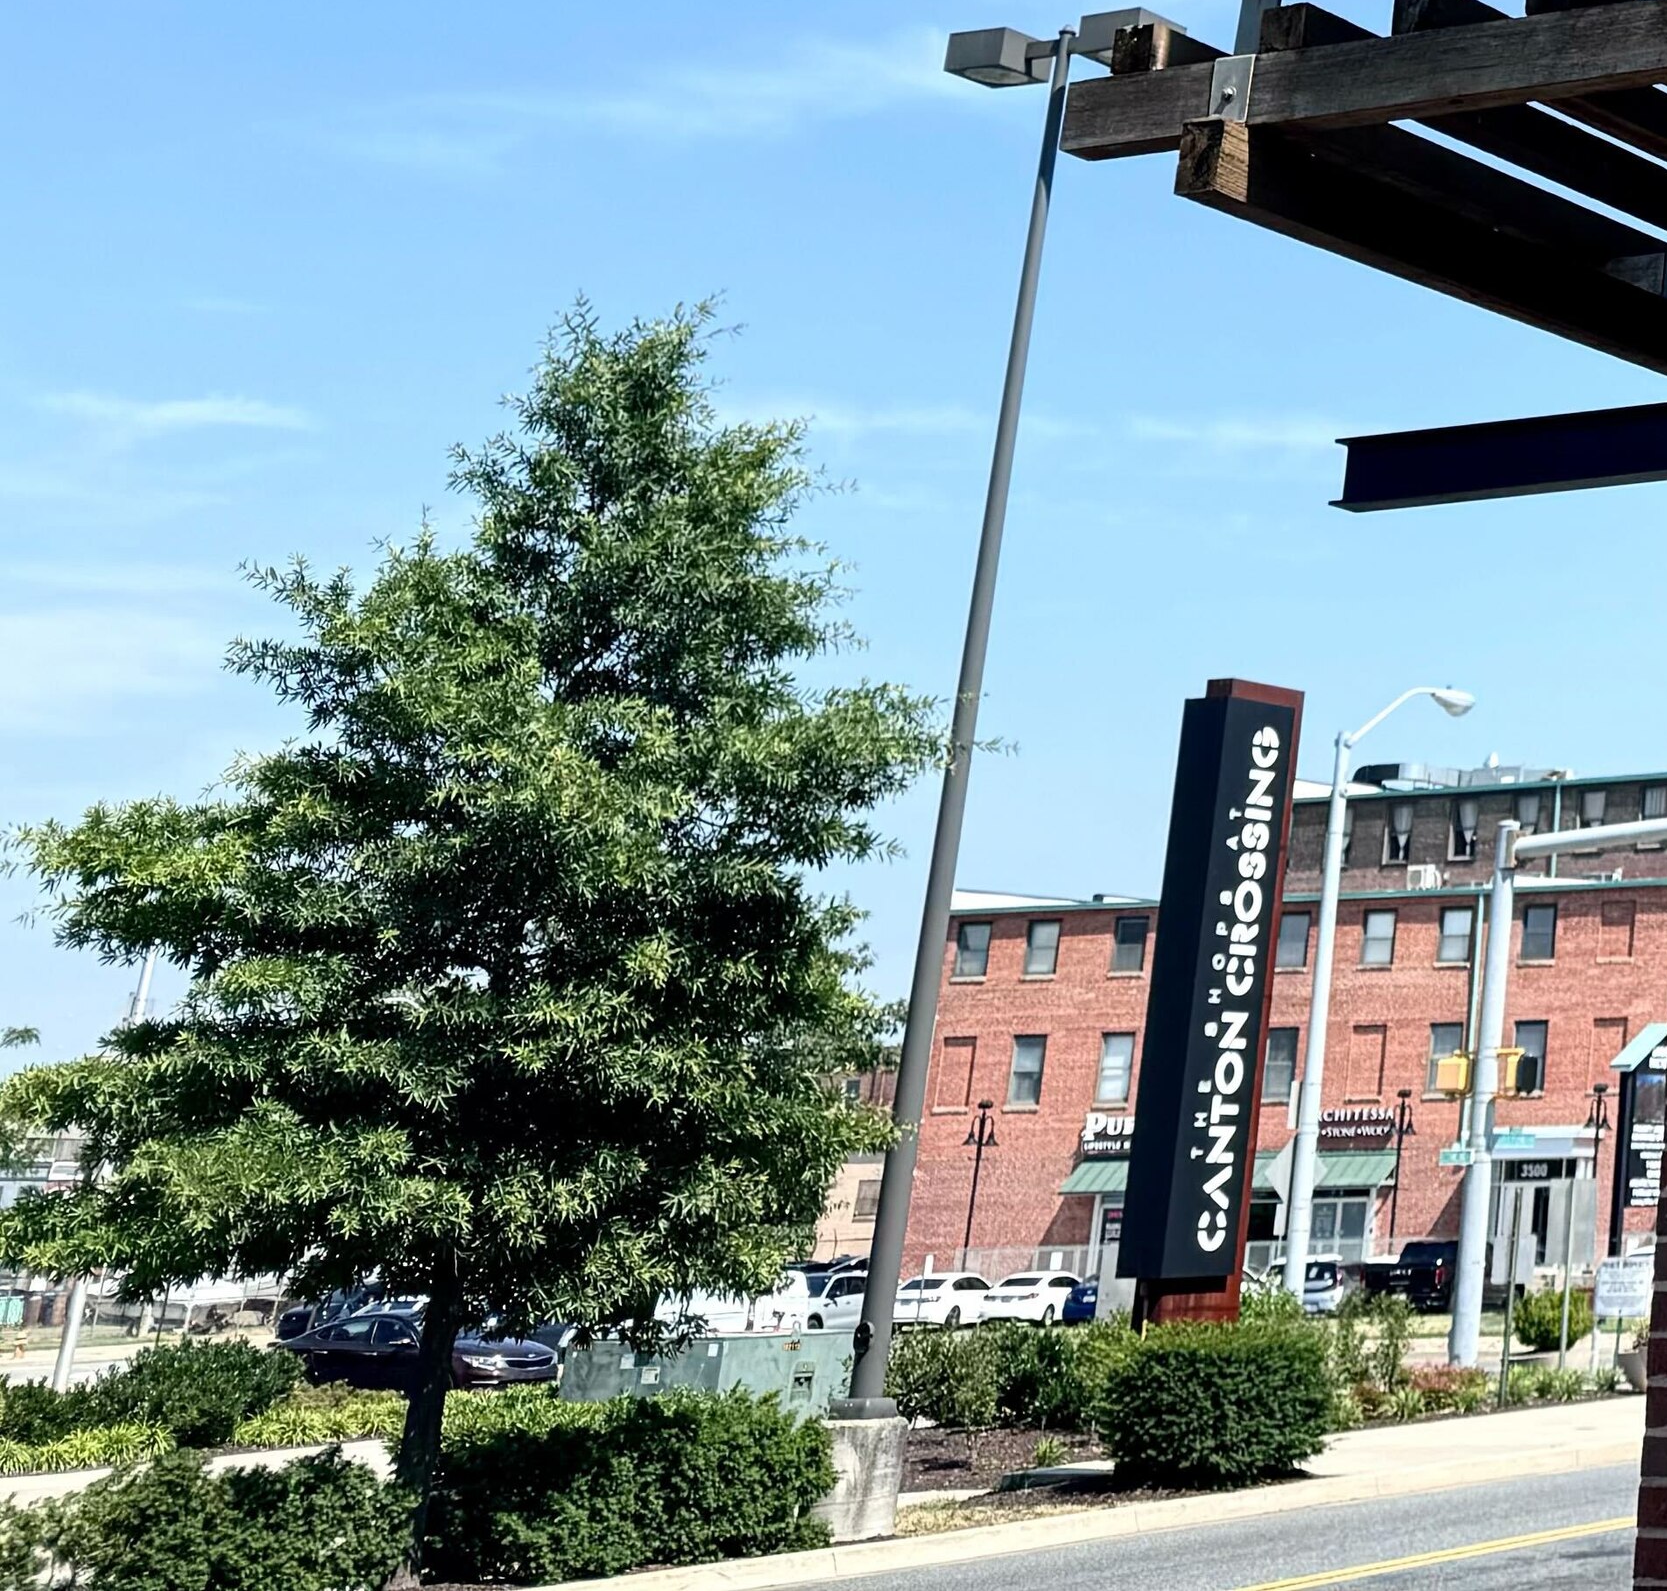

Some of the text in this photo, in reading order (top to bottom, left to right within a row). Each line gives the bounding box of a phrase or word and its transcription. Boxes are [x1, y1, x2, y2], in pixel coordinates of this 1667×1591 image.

[1226, 807, 1243, 851] AT
[1197, 726, 1280, 1252] CANTON CROSSING
